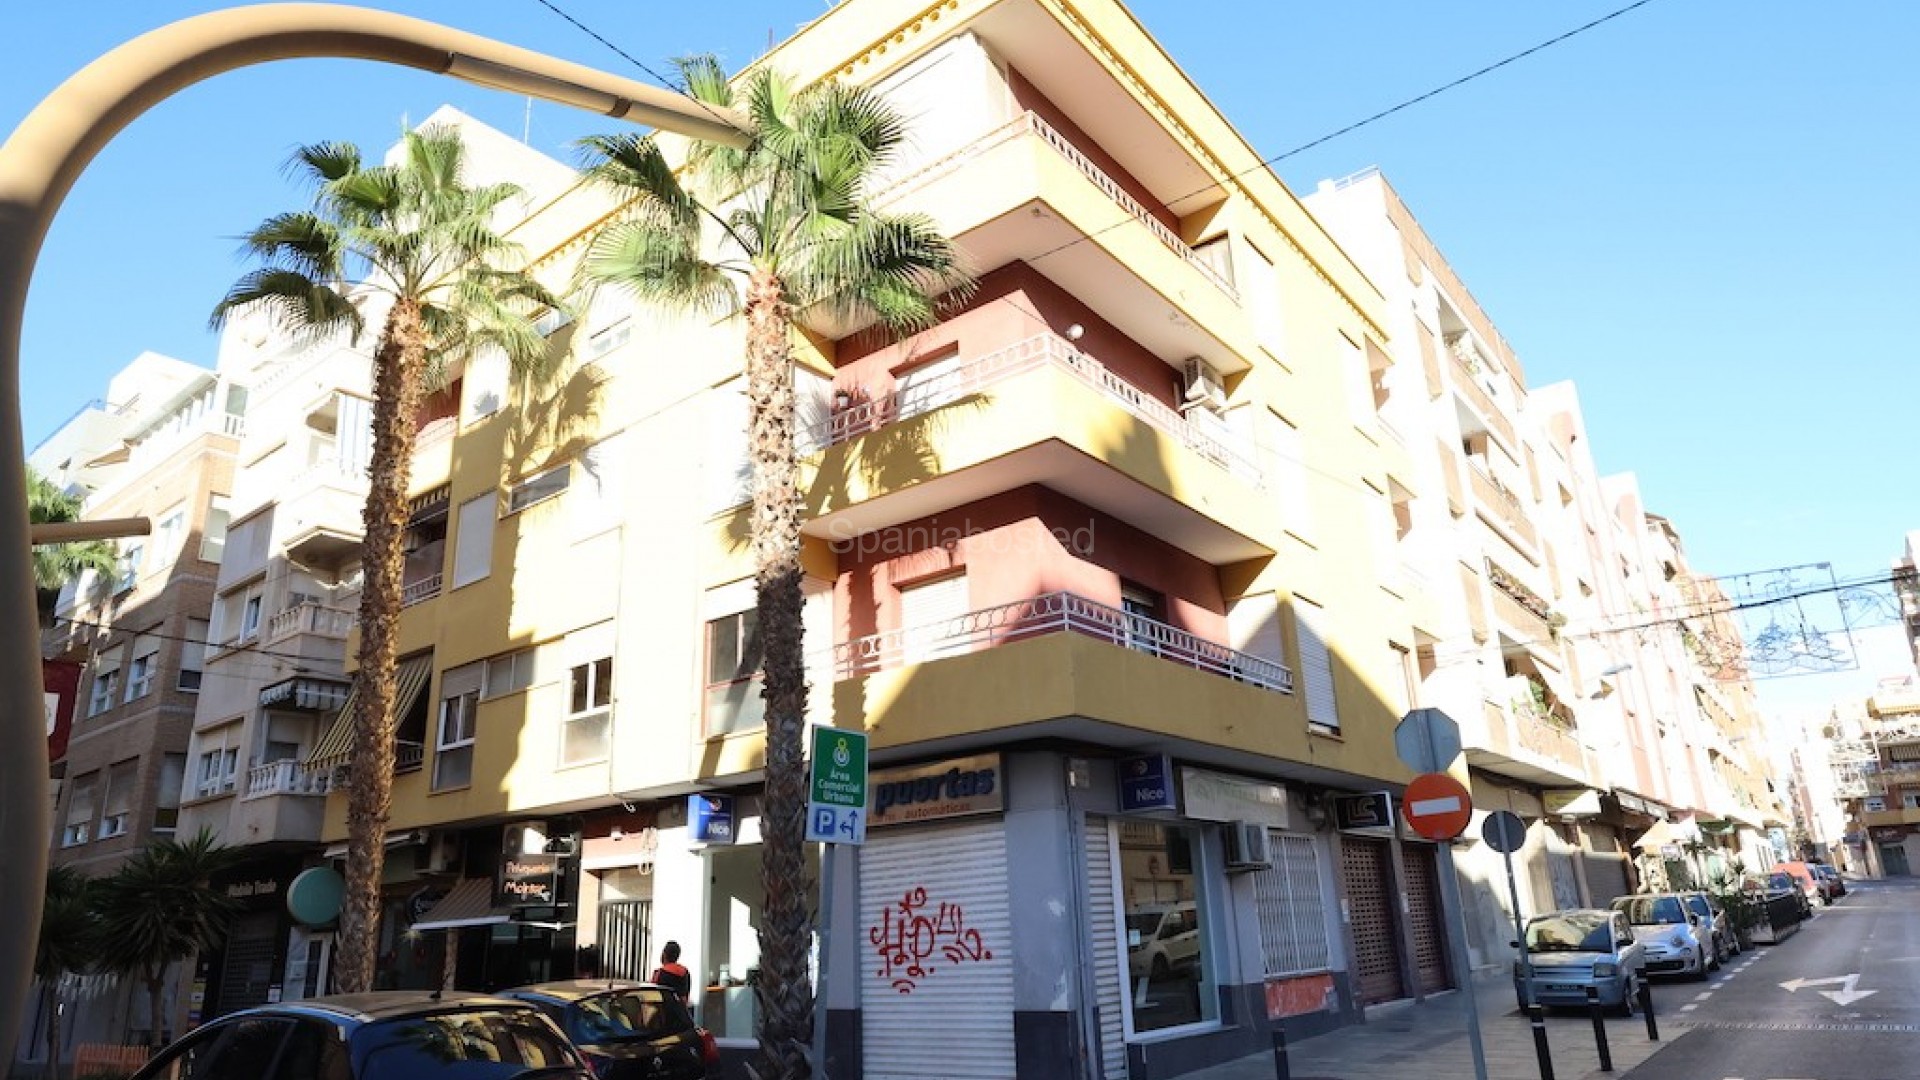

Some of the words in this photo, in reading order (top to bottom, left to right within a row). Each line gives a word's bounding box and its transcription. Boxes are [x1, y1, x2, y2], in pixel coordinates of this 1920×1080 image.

[818, 778, 860, 793] Comercial
[875, 767, 994, 817] puertas
[1136, 787, 1166, 802] Nice
[708, 821, 730, 836] Nice
[818, 810, 833, 833] P
